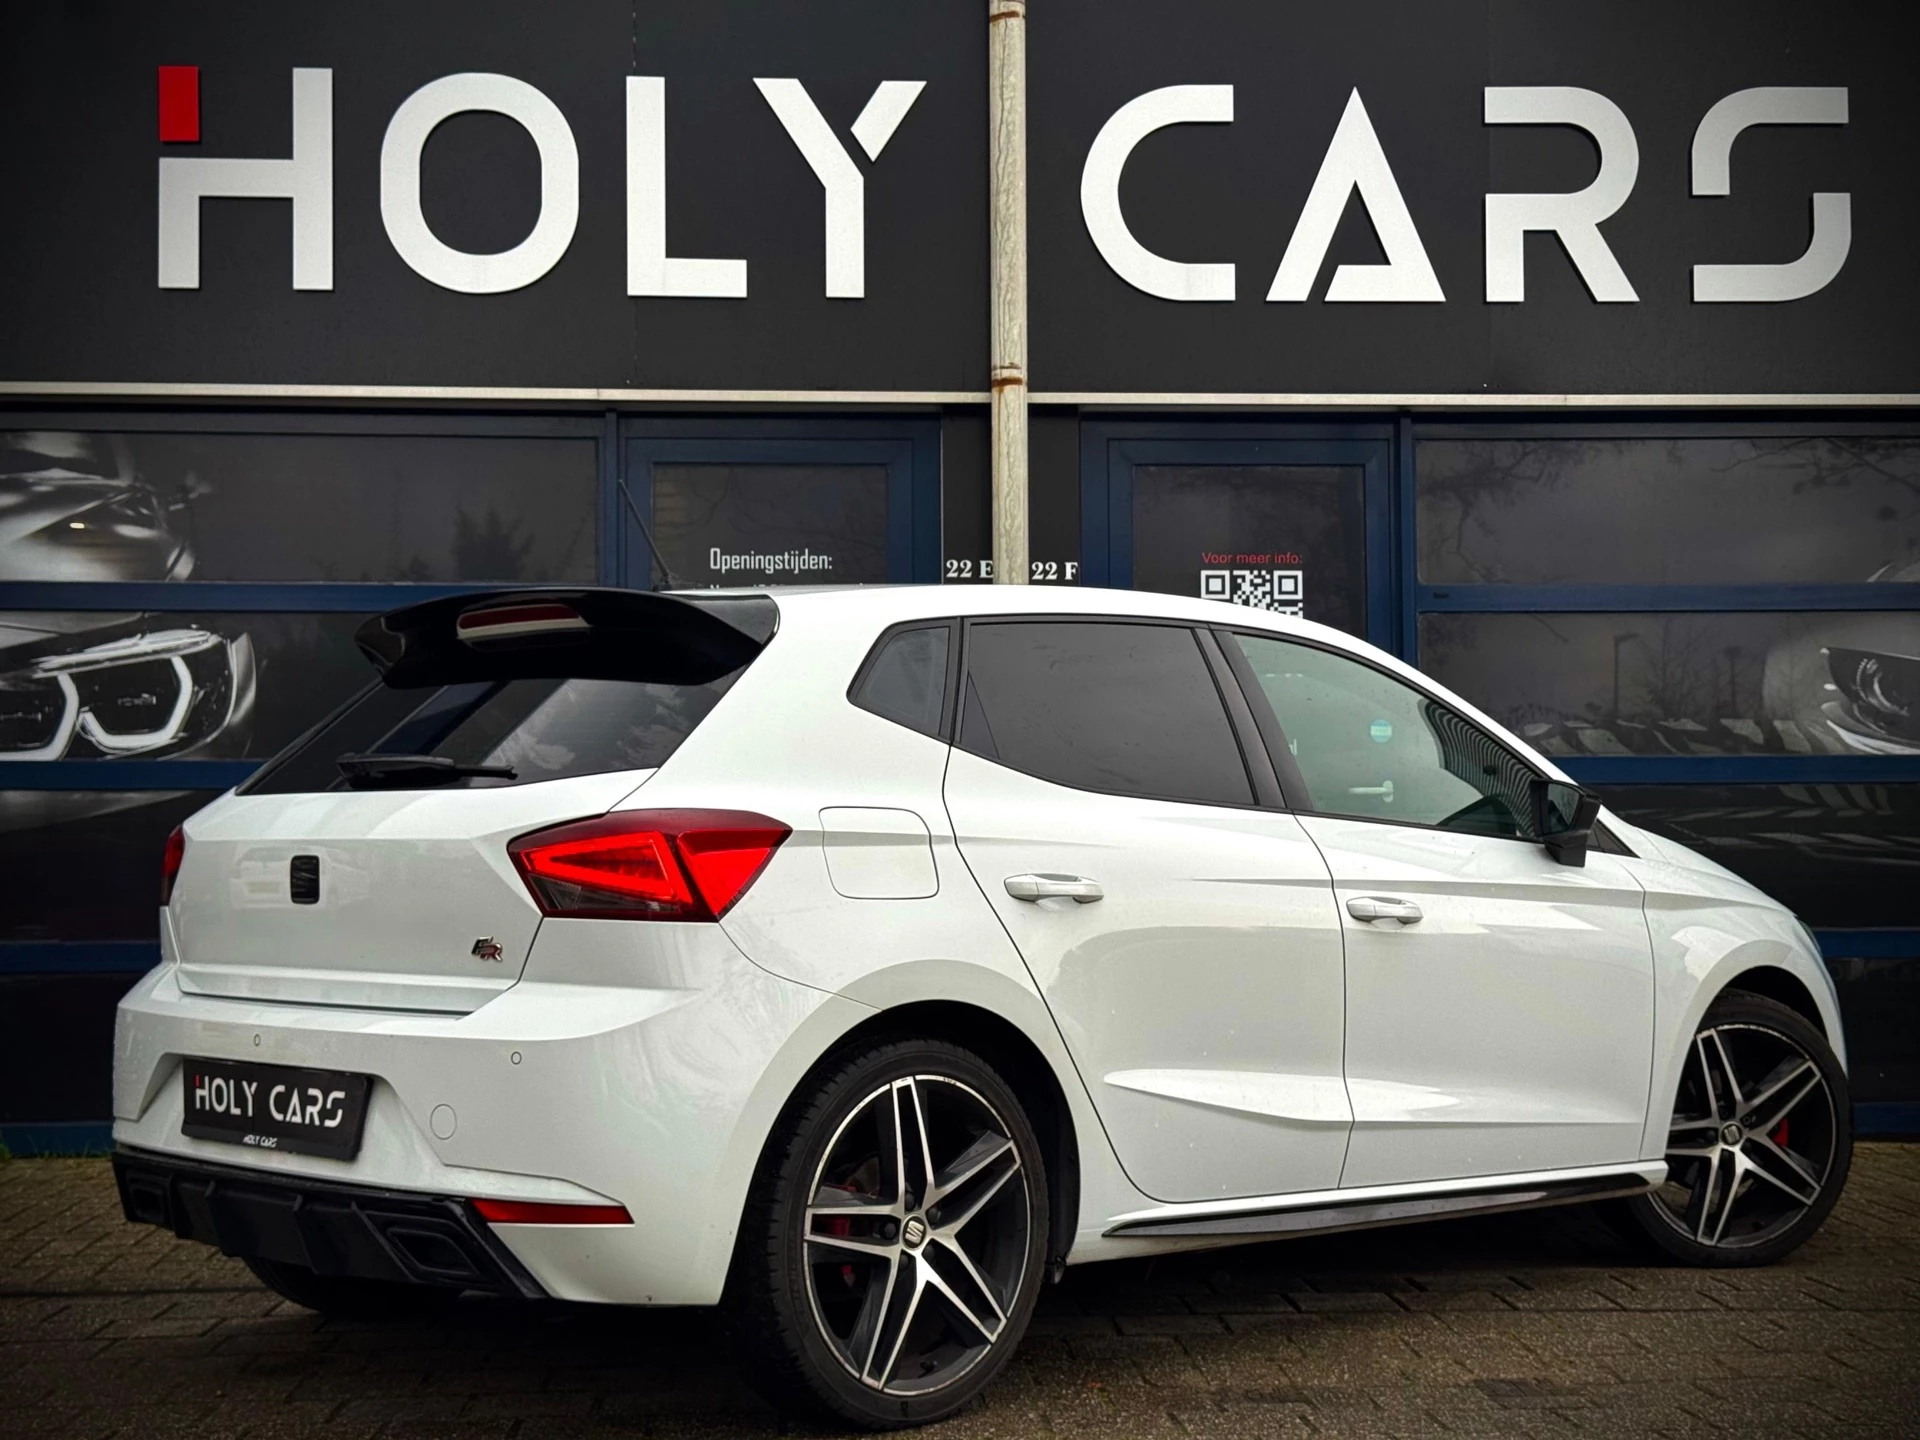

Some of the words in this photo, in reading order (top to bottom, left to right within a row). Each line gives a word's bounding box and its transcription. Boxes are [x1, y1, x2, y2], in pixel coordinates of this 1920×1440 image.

[158, 66, 927, 298] HOLY
[1081, 84, 1852, 302] CARS
[710, 547, 832, 574] Openingstijden:
[946, 559, 972, 578] 22
[979, 560, 994, 578] E
[1031, 561, 1058, 580] 22
[1064, 562, 1079, 580] F
[1202, 552, 1233, 564] Voor
[1236, 554, 1271, 564] meer
[1274, 552, 1303, 564] info:
[471, 936, 503, 961] FR
[194, 1074, 258, 1117] HOLY
[269, 1085, 346, 1128] CARS
